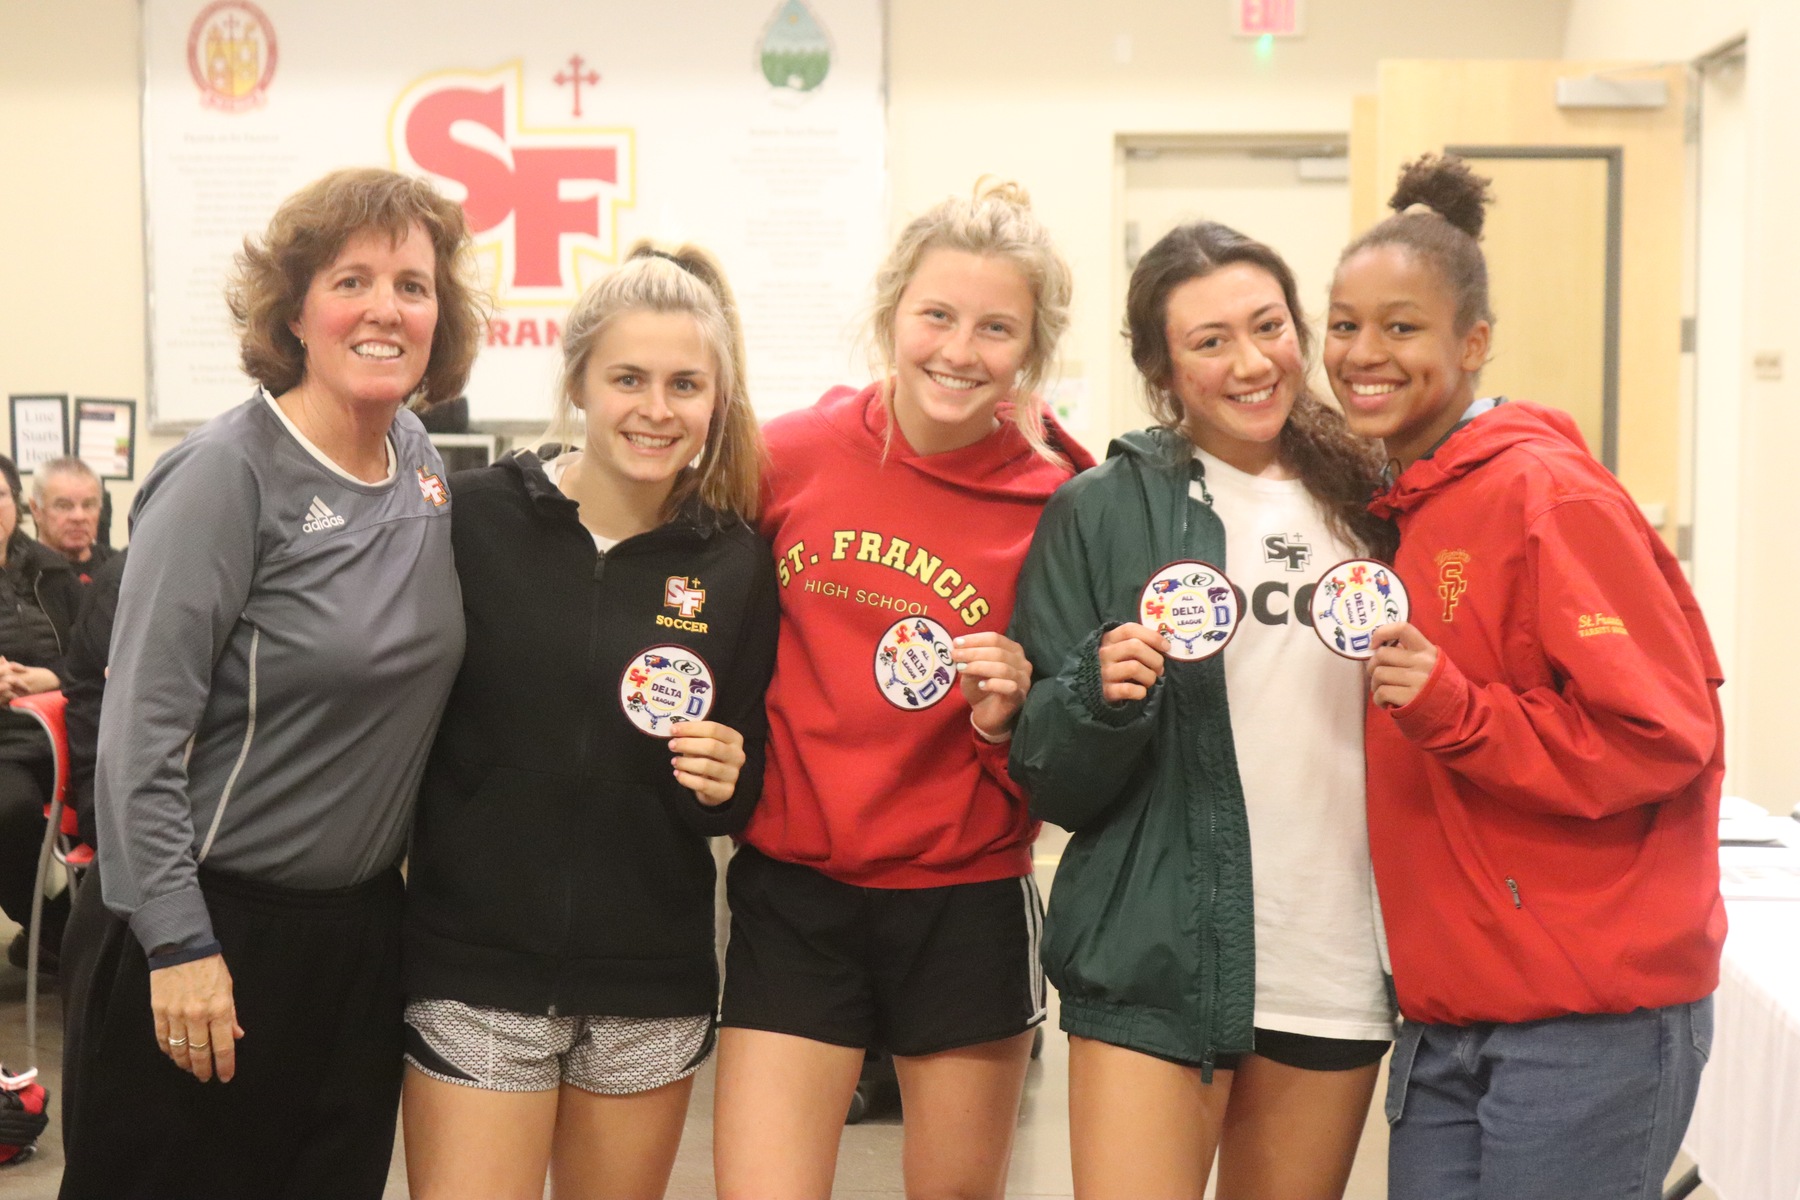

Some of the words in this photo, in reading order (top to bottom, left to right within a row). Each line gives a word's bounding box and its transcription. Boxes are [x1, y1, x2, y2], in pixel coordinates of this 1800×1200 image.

[402, 82, 619, 288] SF
[302, 514, 345, 534] adidas
[1262, 533, 1312, 572] SF
[778, 541, 820, 588] ST.
[831, 529, 990, 627] FRANCIS
[664, 576, 706, 618] SF
[804, 579, 849, 599] HIGH
[1145, 601, 1165, 619] SF
[1172, 605, 1205, 617] DELTA
[1213, 605, 1231, 626] D
[1345, 598, 1355, 624] LEAGUE
[1353, 592, 1367, 625] DELTA
[655, 614, 709, 634] SOCCER
[1177, 618, 1202, 626] LEAGUE
[901, 659, 918, 679] LEAGUE
[906, 648, 927, 677] DELTA
[629, 668, 649, 688] SF
[651, 683, 682, 699] DELTA
[652, 695, 676, 707] LEAGUE
[685, 695, 704, 716] D
